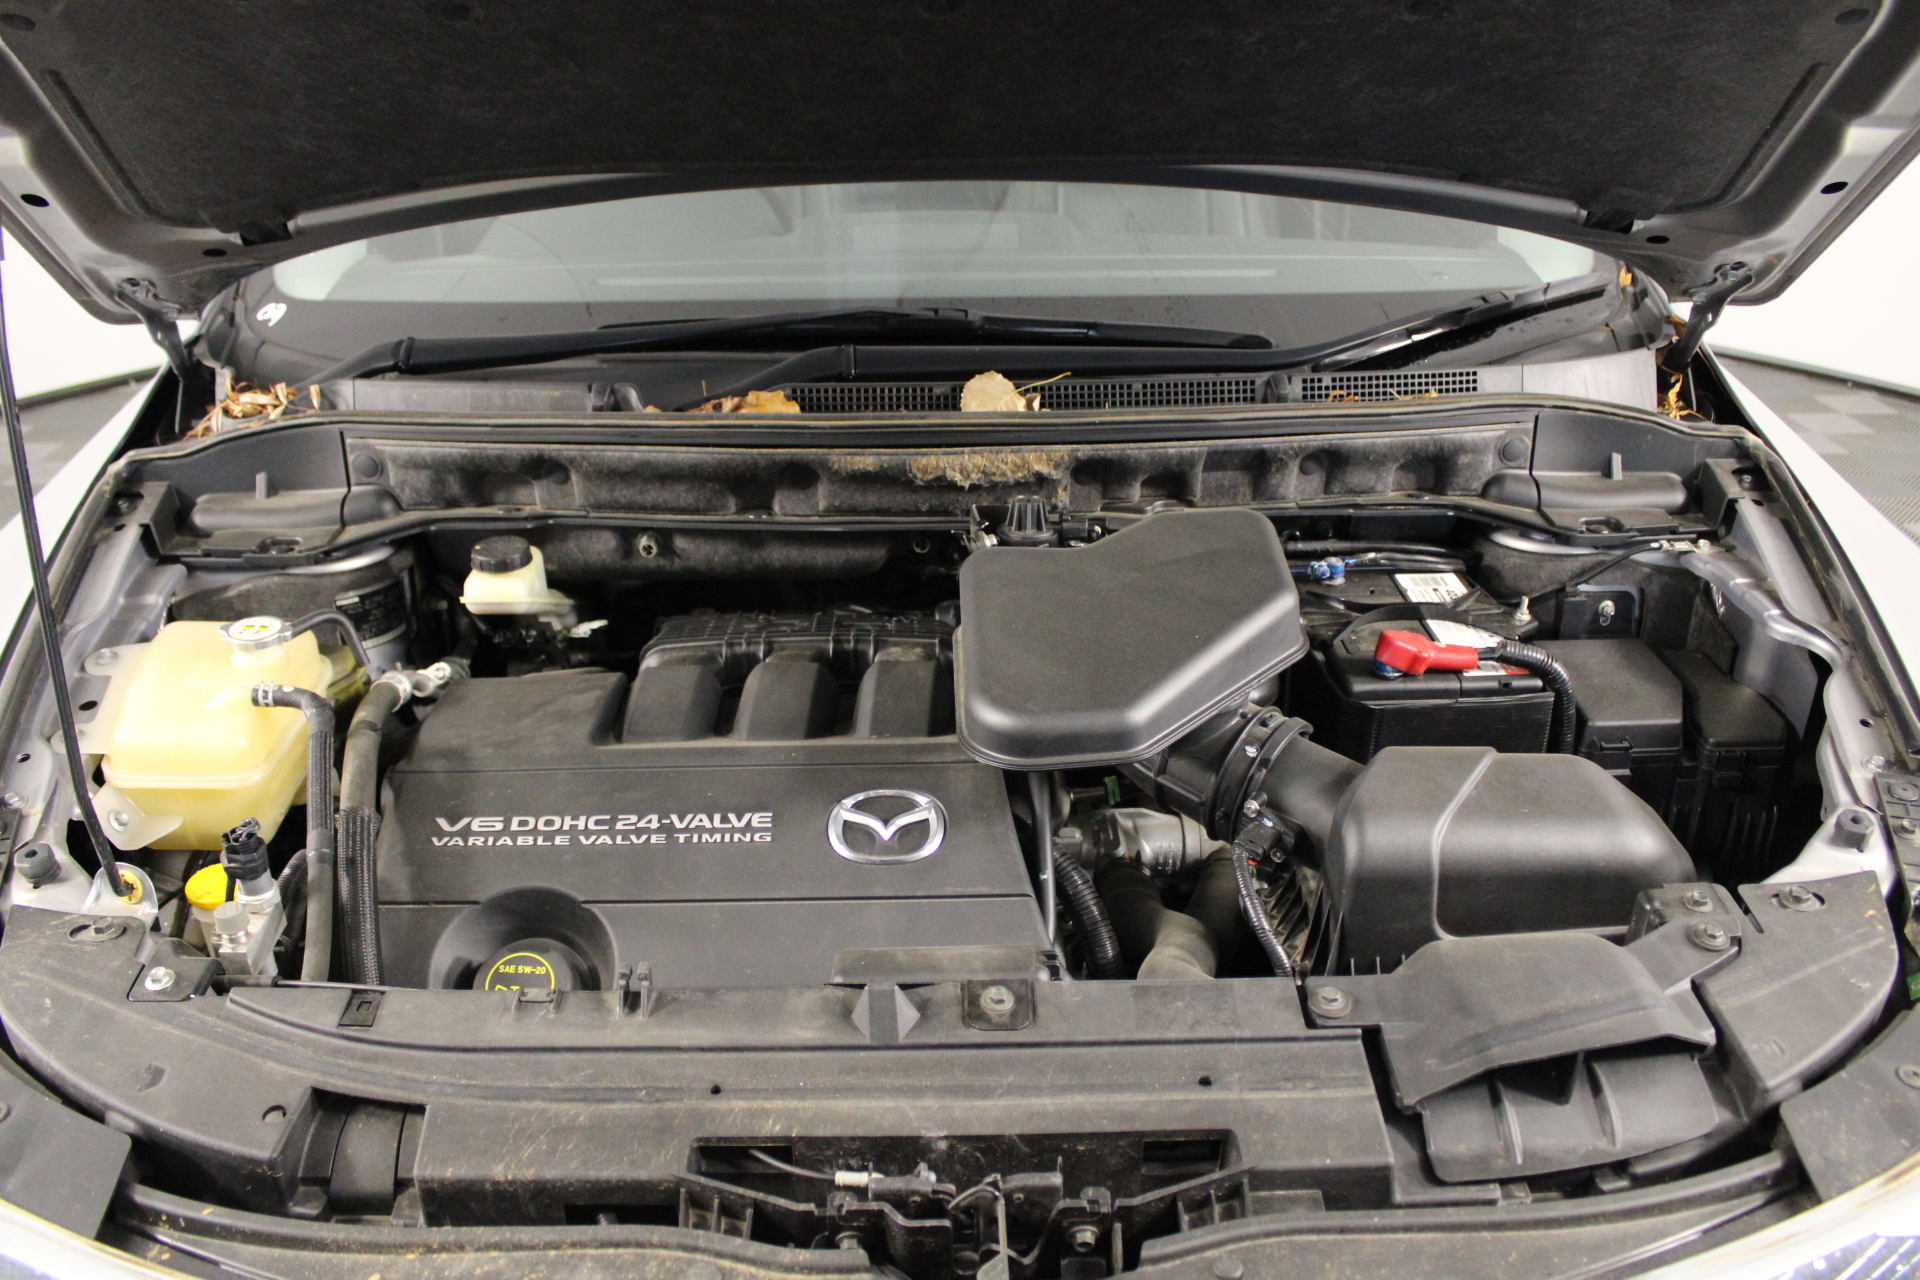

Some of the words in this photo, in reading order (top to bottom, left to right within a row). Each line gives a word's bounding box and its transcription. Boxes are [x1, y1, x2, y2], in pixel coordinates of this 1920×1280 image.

[435, 816, 505, 832] V6
[510, 815, 611, 832] DOHC
[615, 812, 773, 830] 24-VALVE
[431, 835, 571, 847] VARIABLE
[578, 834, 667, 846] VALVE
[673, 832, 772, 845] TIMING
[499, 965, 516, 973] SAE
[517, 966, 546, 974] 5W-20
